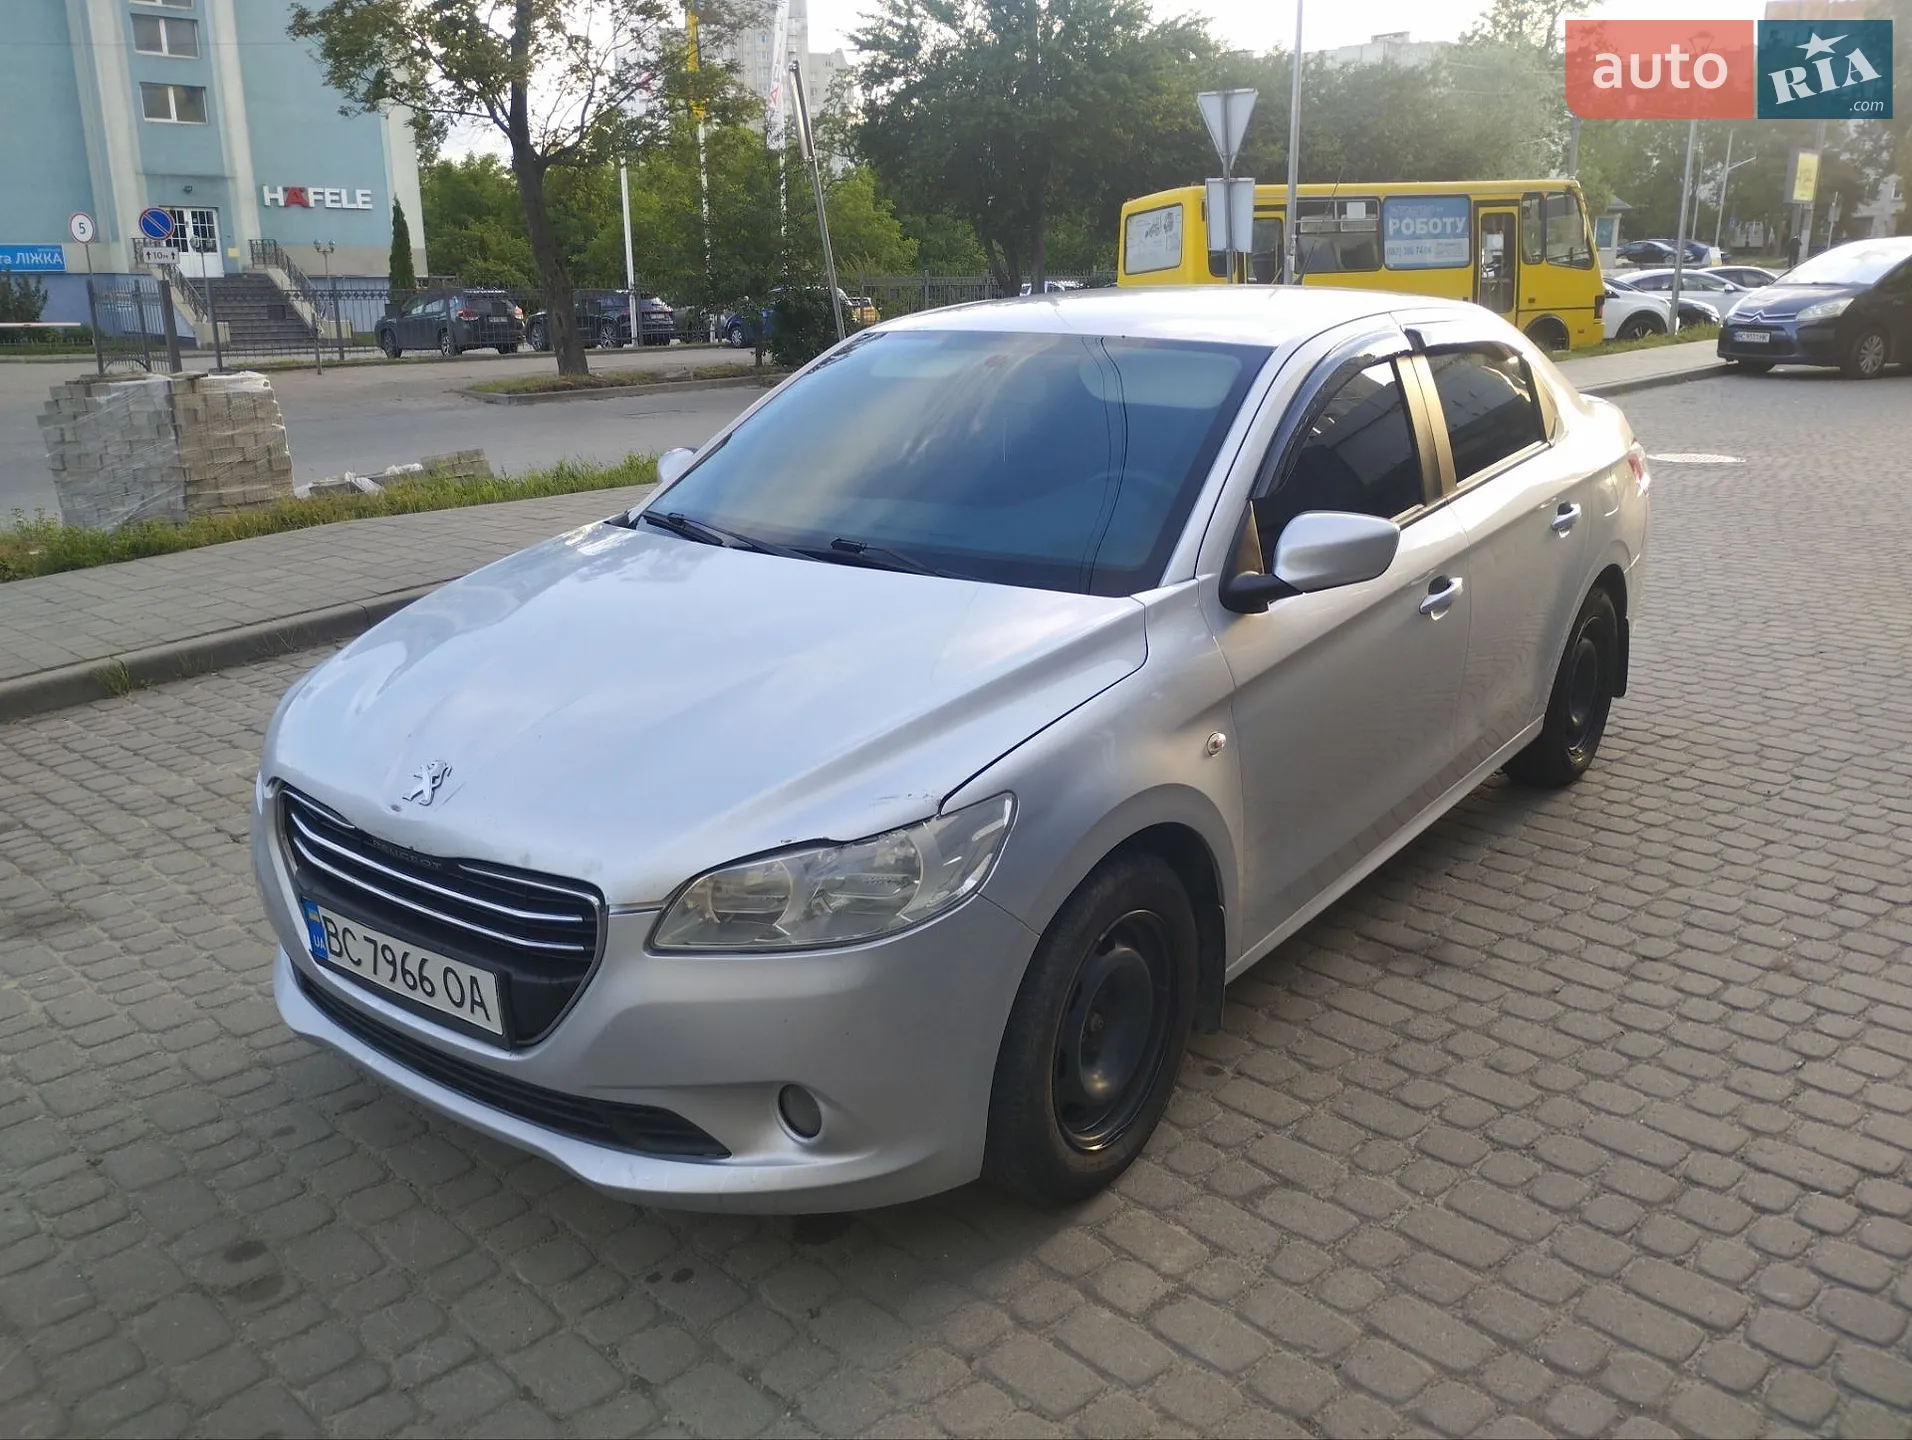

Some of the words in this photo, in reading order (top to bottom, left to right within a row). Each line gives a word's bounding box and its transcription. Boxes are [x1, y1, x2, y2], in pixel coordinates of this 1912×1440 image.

[78, 222, 86, 234] 5
[1388, 216, 1467, 236] РОБОТУ
[15, 252, 64, 265] ЛІЖКА
[313, 934, 327, 951] UA
[321, 914, 363, 967] BC
[363, 935, 436, 998] 7966
[443, 966, 491, 1022] OA
